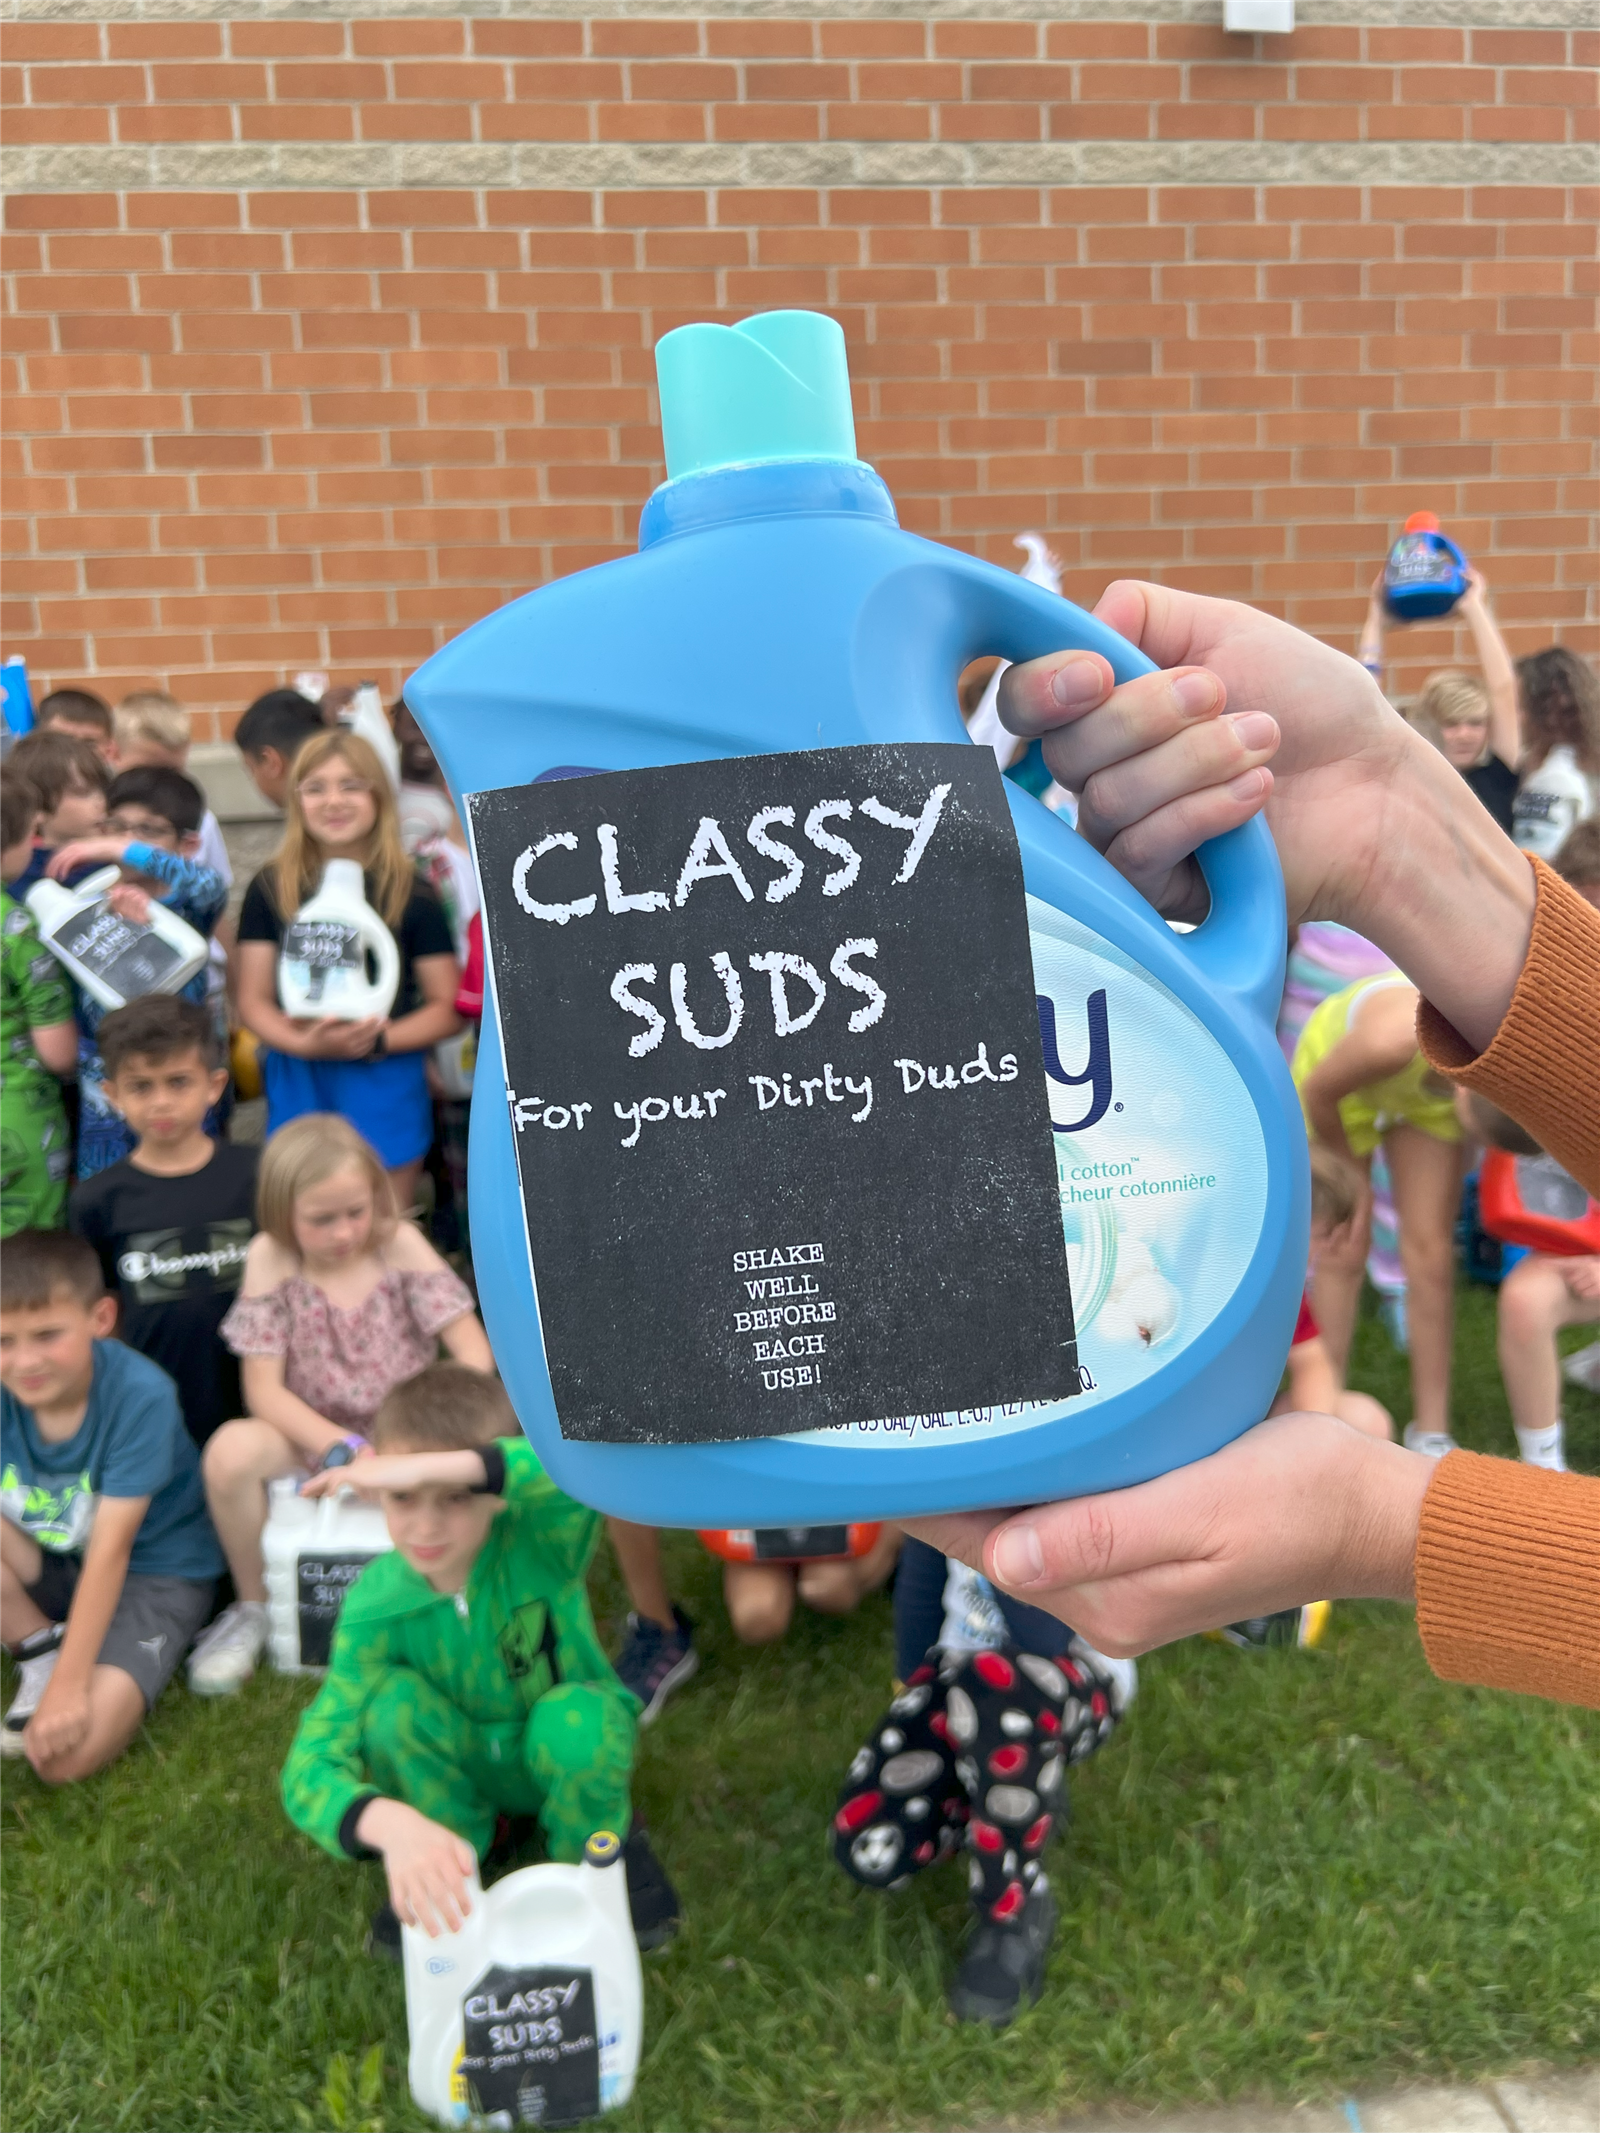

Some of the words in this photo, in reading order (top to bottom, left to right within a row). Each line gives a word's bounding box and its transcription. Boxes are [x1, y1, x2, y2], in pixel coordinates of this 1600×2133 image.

[512, 783, 952, 925] CLASSY
[610, 937, 886, 1058] SUDS
[511, 1091, 593, 1132] For
[614, 1087, 727, 1148] your
[749, 1064, 873, 1122] Dirty
[894, 1043, 1018, 1095] Duds
[1119, 1173, 1216, 1198] cotonnière
[733, 1243, 825, 1273] SHAKE
[743, 1274, 820, 1300] WELL
[733, 1301, 837, 1333] BEFORE
[752, 1334, 826, 1361] EACH
[761, 1364, 822, 1390] USE!
[465, 1978, 581, 2022] CLASSY
[488, 2016, 563, 2051] SUDS
